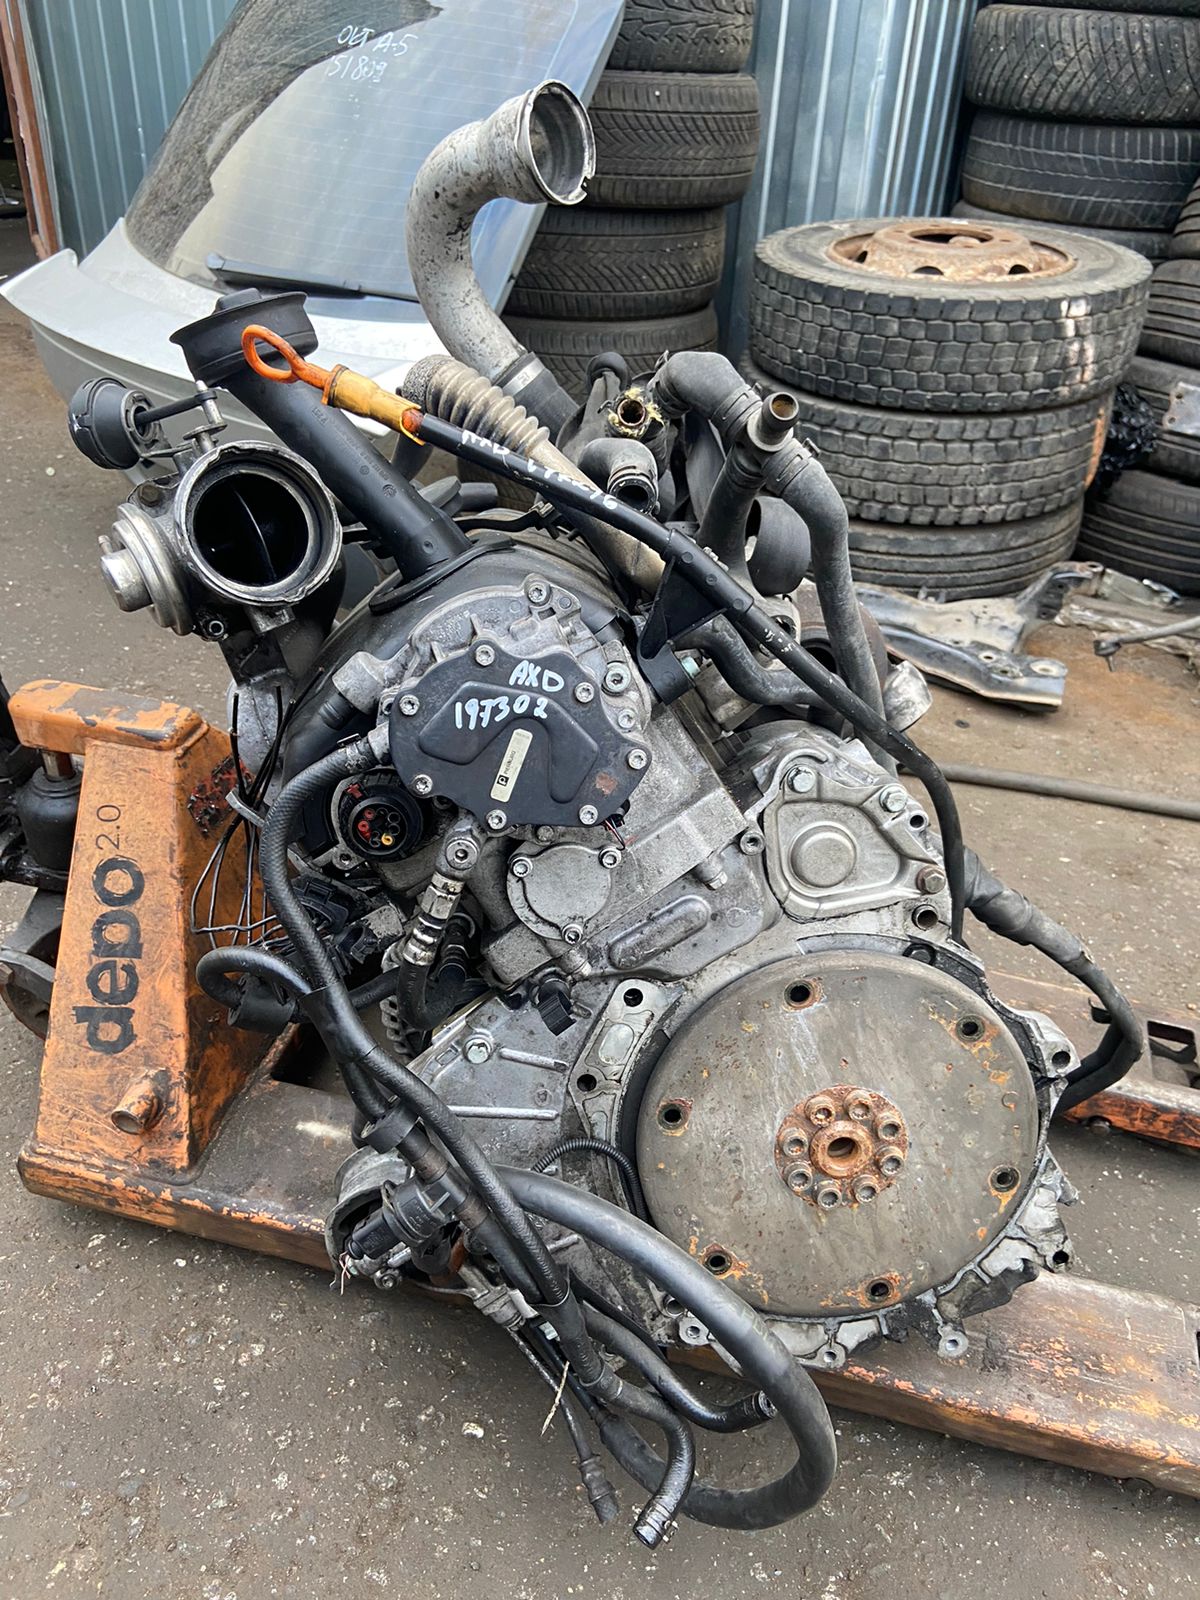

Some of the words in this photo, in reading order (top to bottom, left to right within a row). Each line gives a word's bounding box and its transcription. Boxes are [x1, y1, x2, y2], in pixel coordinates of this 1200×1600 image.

[508, 659, 565, 692] AXD
[95, 803, 122, 851] 2.0
[72, 856, 146, 1056] depo
